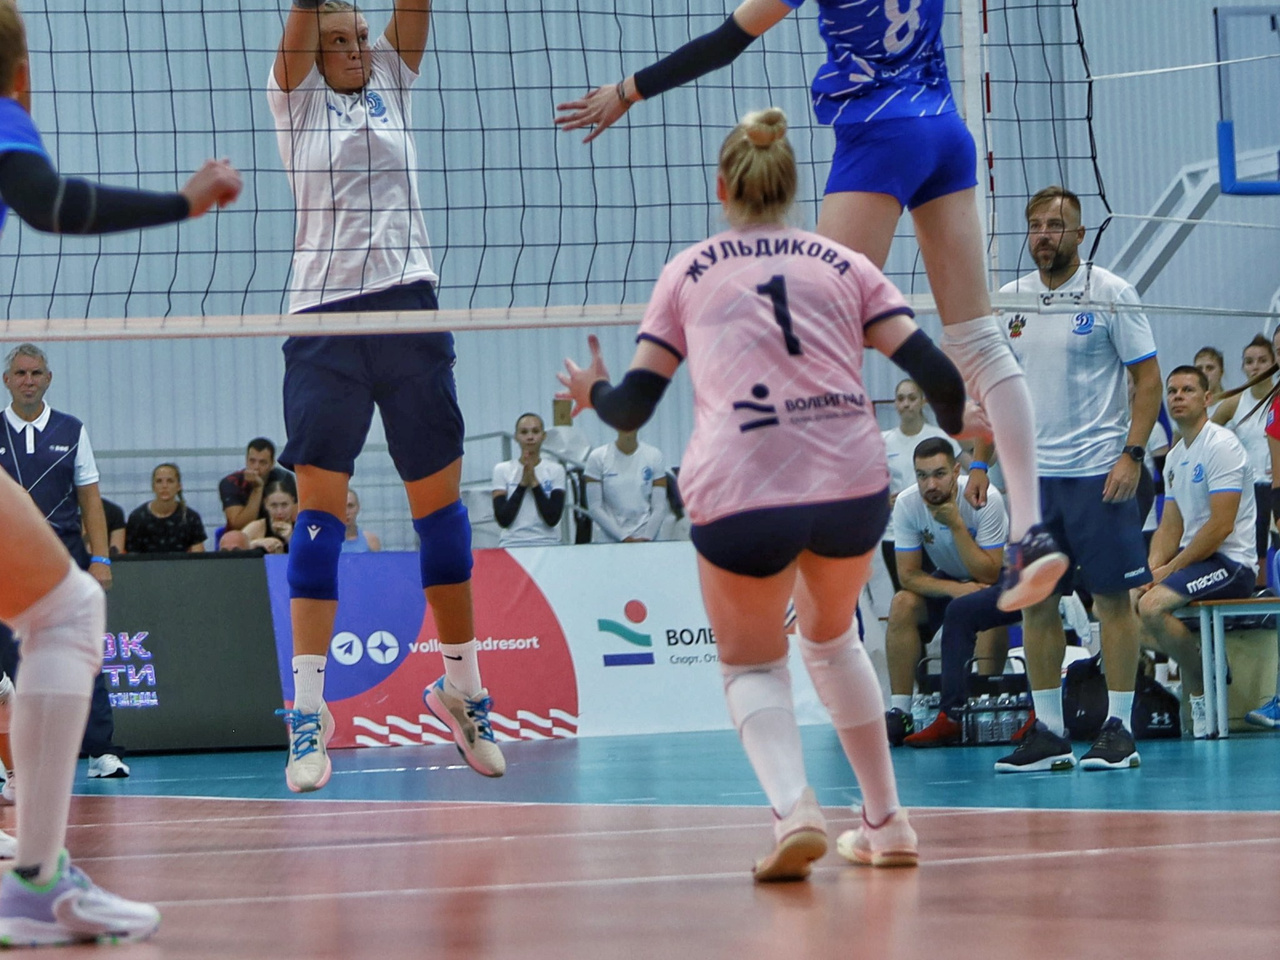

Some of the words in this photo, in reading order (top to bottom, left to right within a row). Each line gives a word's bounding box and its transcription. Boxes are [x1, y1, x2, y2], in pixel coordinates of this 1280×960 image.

[685, 238, 852, 283] ЖУЛЬДИКОВА
[756, 275, 804, 356] 1
[1186, 568, 1229, 594] macron
